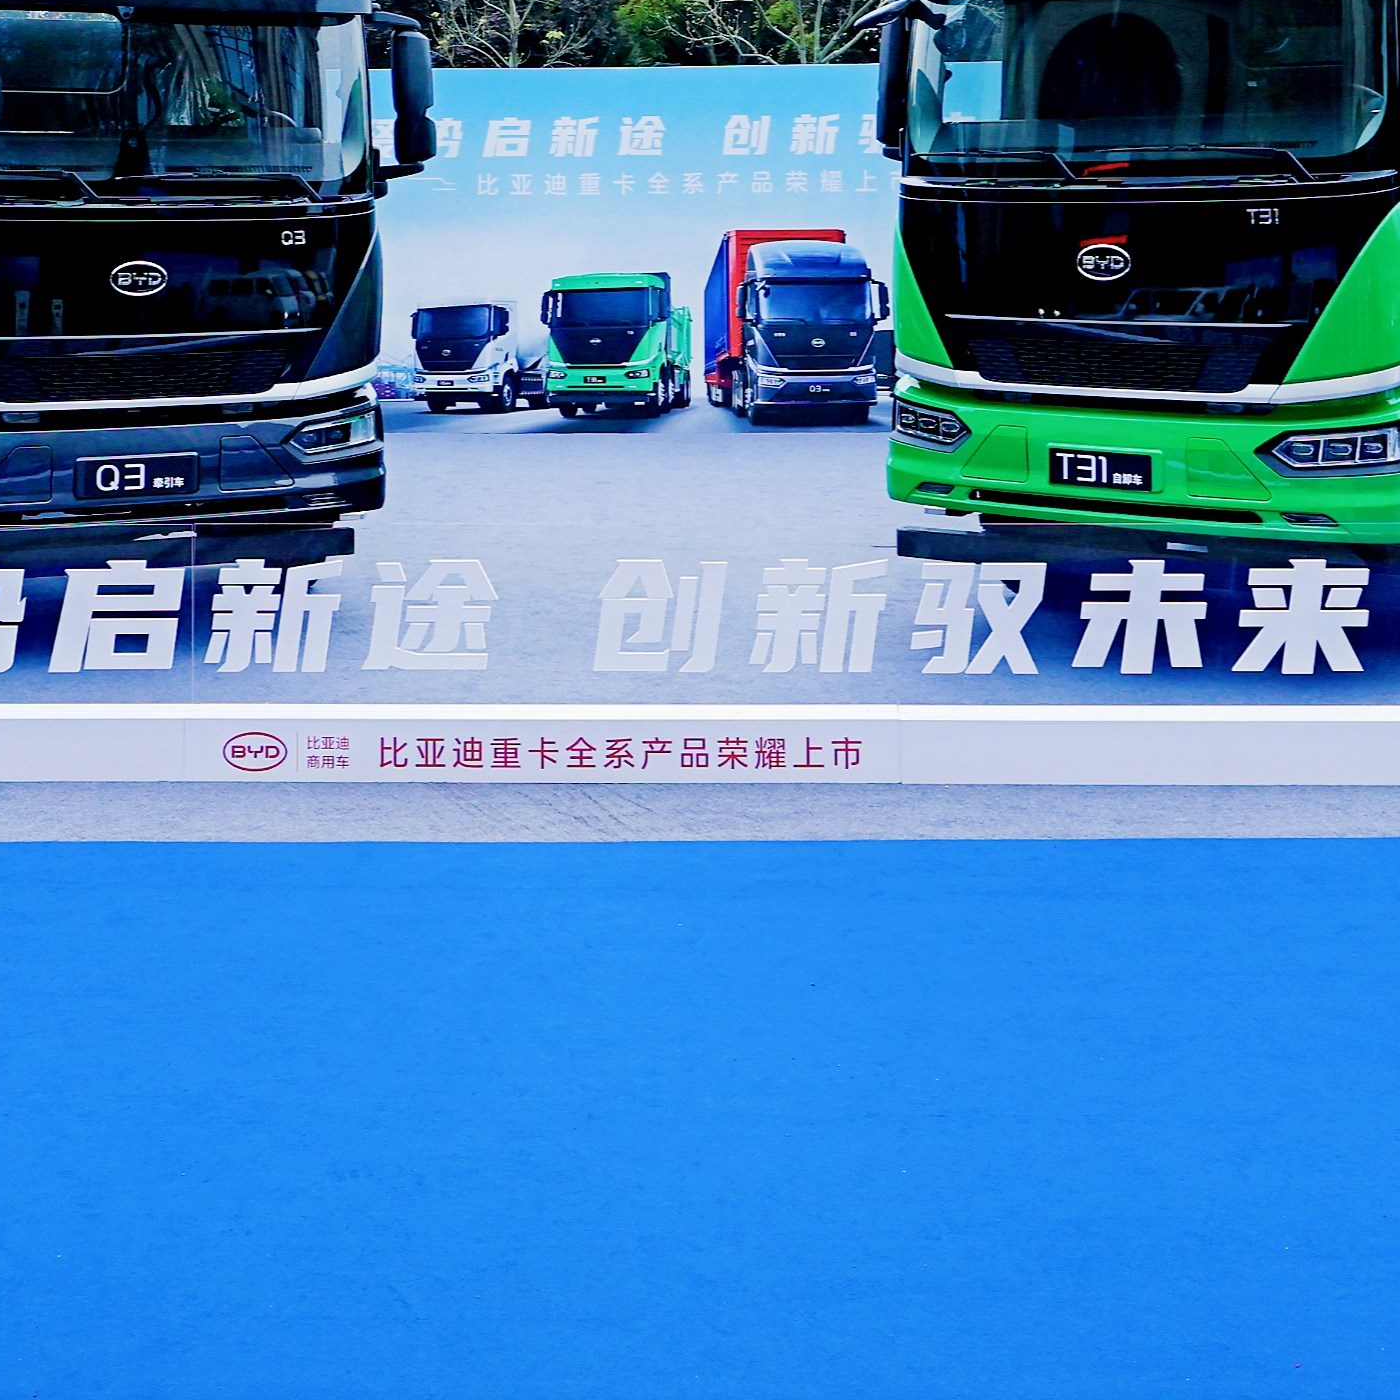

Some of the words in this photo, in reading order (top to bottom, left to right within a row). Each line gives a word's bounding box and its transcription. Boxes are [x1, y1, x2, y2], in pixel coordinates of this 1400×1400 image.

[1246, 208, 1280, 225] T31
[281, 230, 307, 246] Q3
[1055, 453, 1108, 484] T31
[96, 464, 146, 492] Q3
[152, 476, 185, 489] 牵引车
[1112, 473, 1144, 486] 自卸车
[592, 558, 1371, 675] 创新驭未来
[305, 736, 351, 751] 比亚迪
[378, 735, 863, 770] 比亚迪重卡全系产品荣耀上市
[305, 754, 351, 770] 商用车
